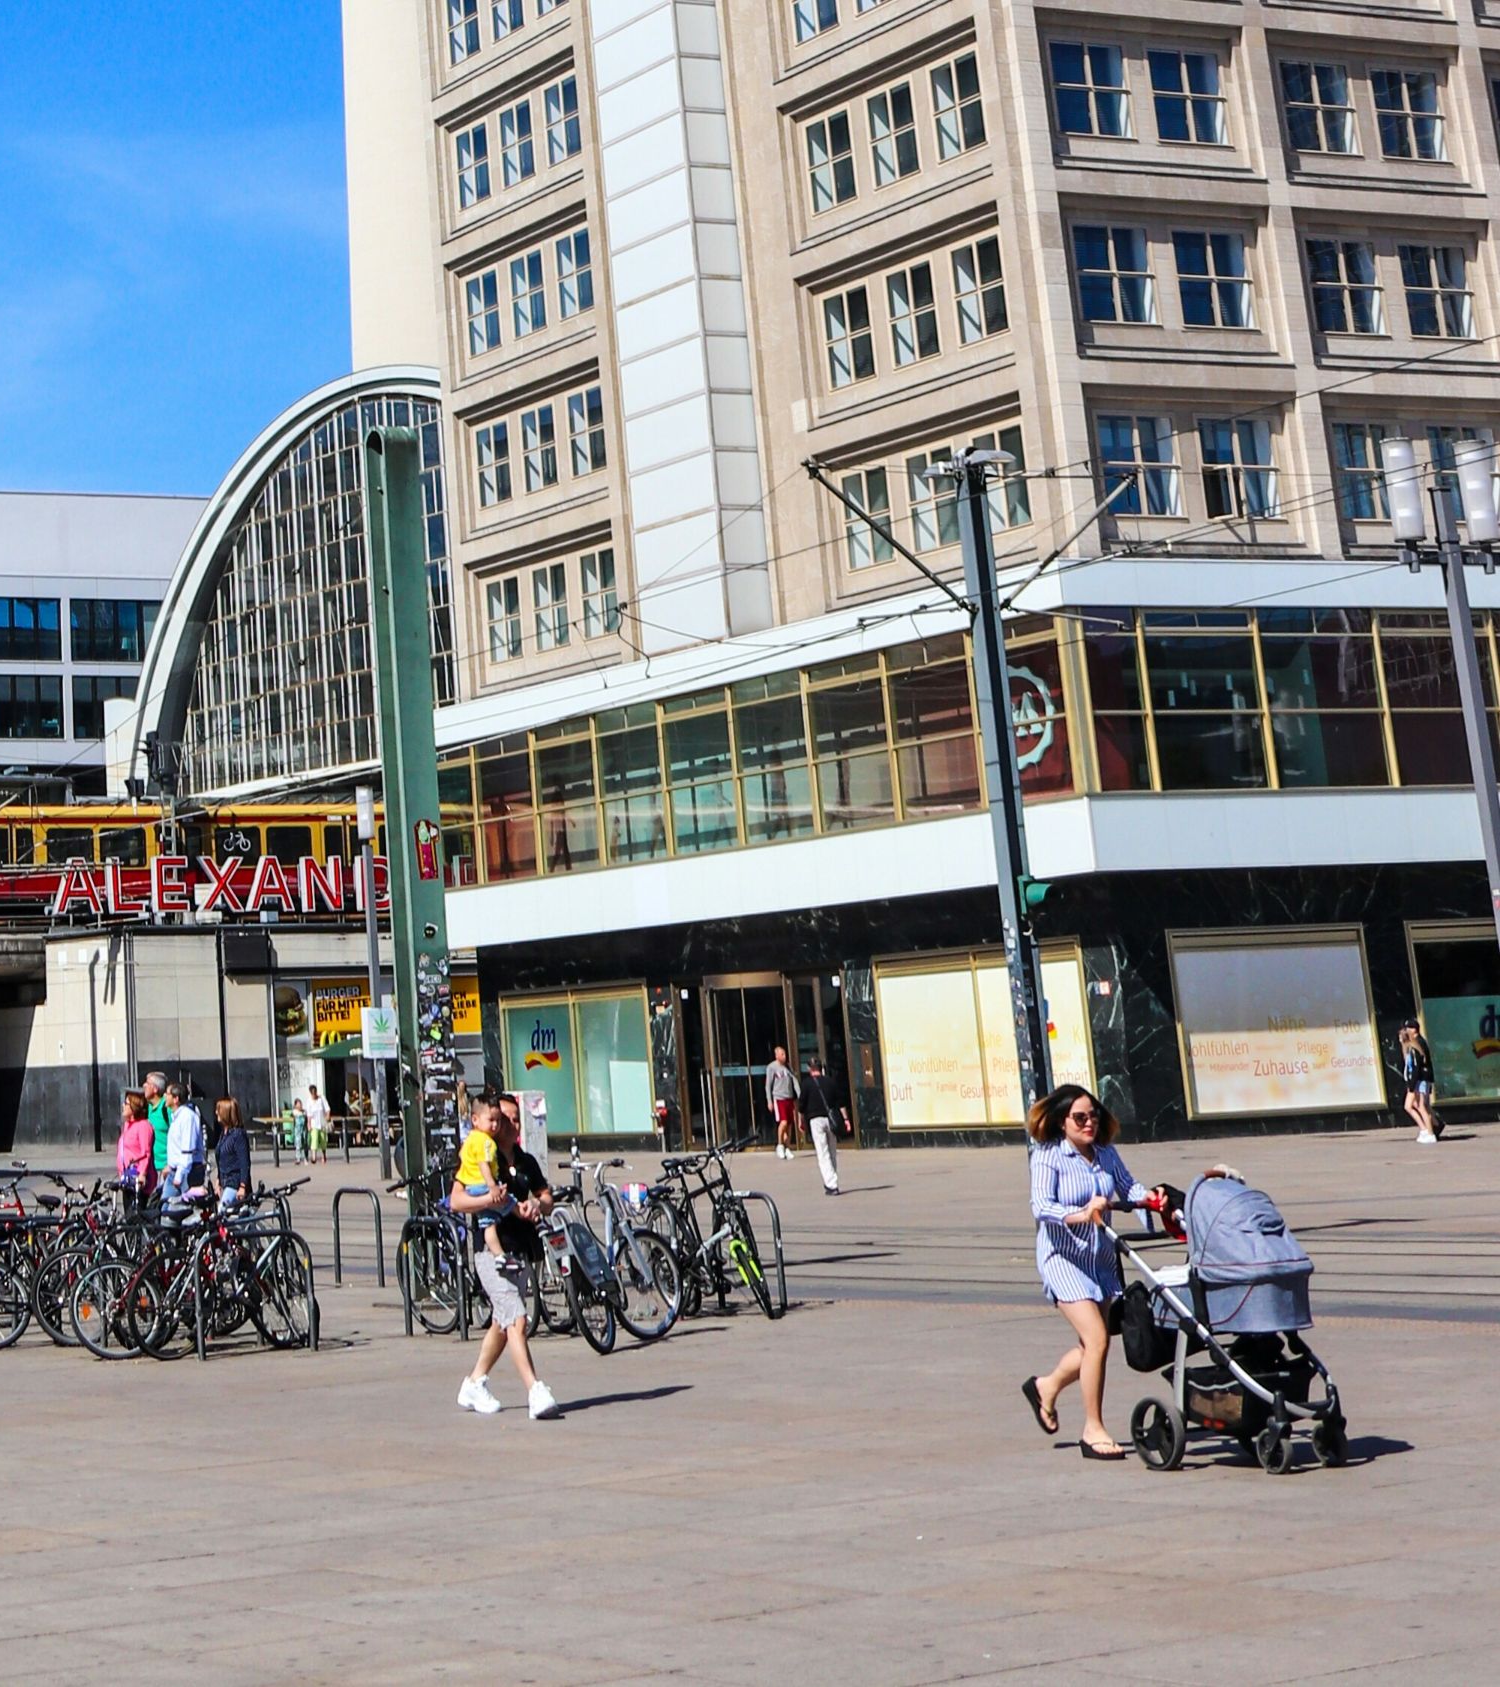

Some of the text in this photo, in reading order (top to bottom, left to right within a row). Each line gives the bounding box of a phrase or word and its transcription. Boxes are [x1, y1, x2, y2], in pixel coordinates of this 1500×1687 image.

[315, 985, 361, 1000] BURGER
[316, 998, 335, 1013] FÜR
[317, 1010, 350, 1023] BITTE!
[1267, 1014, 1308, 1034] Nähe
[1333, 1018, 1361, 1034] Foto
[530, 1019, 556, 1051] dm
[1296, 1041, 1329, 1056] Pflege
[1253, 1059, 1309, 1077] Zuhause
[891, 1083, 914, 1102] Duft
